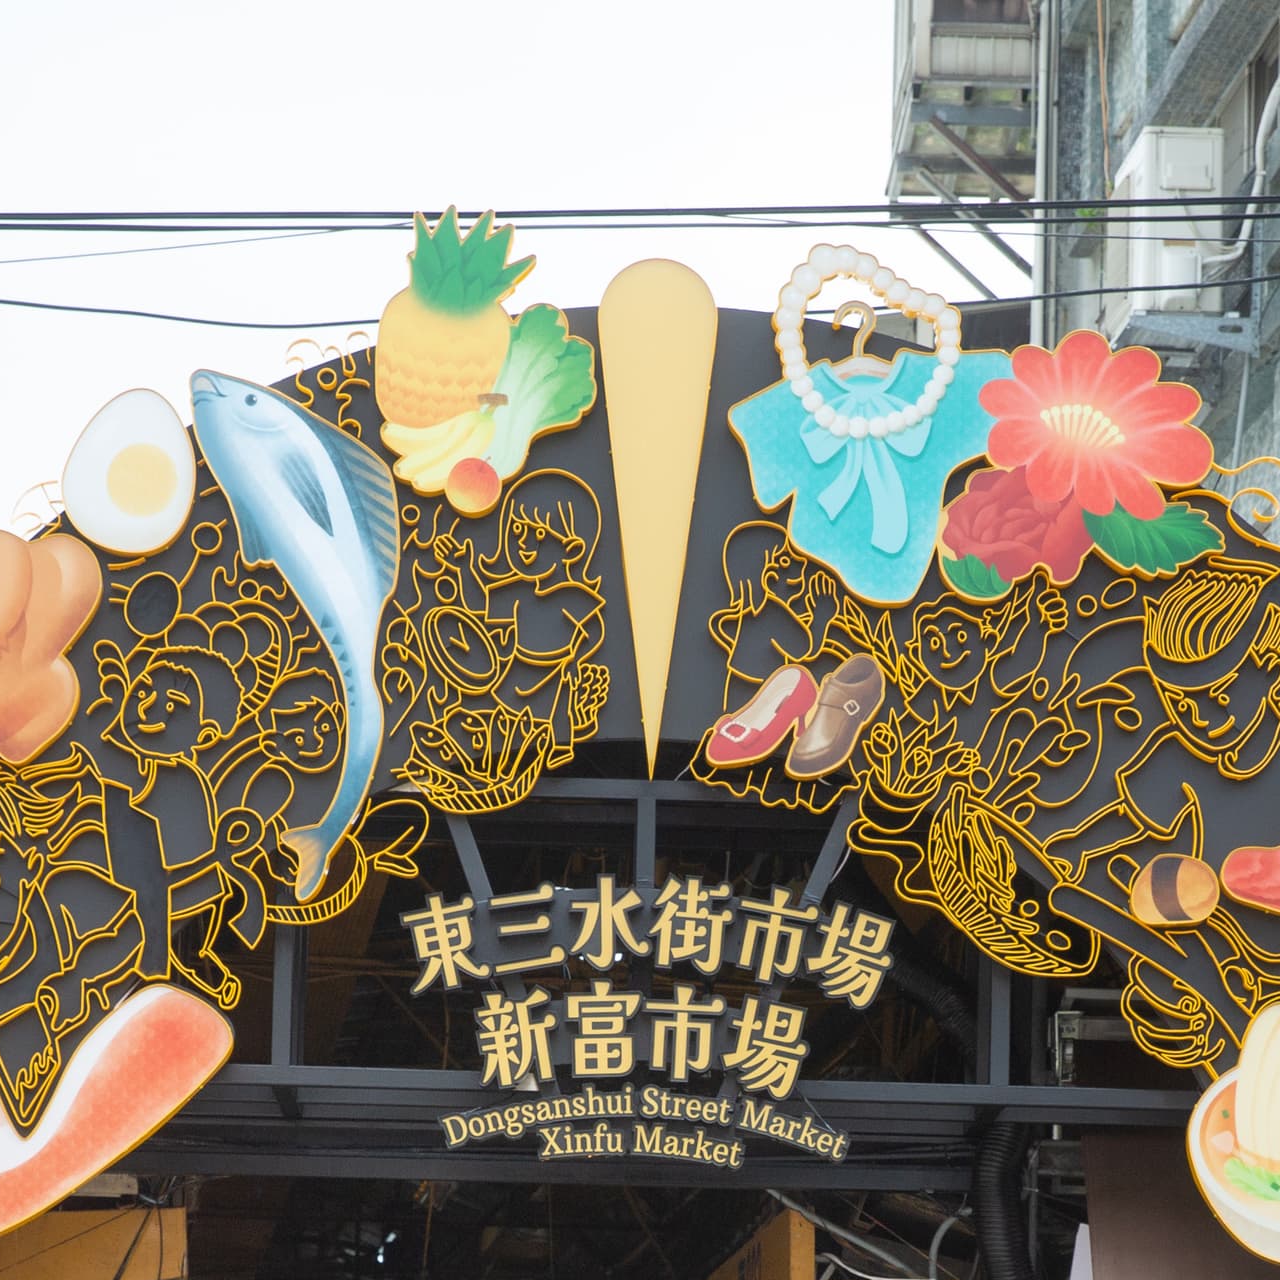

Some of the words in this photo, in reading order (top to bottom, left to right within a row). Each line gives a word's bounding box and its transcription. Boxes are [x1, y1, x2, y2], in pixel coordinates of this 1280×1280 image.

[402, 875, 895, 1007] 東三水街市場
[476, 980, 809, 1097] 新富市場
[442, 1087, 633, 1148] Dongsanshui
[642, 1087, 731, 1125] Street
[742, 1099, 848, 1161] Market
[539, 1125, 624, 1157] Xinfu
[633, 1125, 743, 1168] Market
